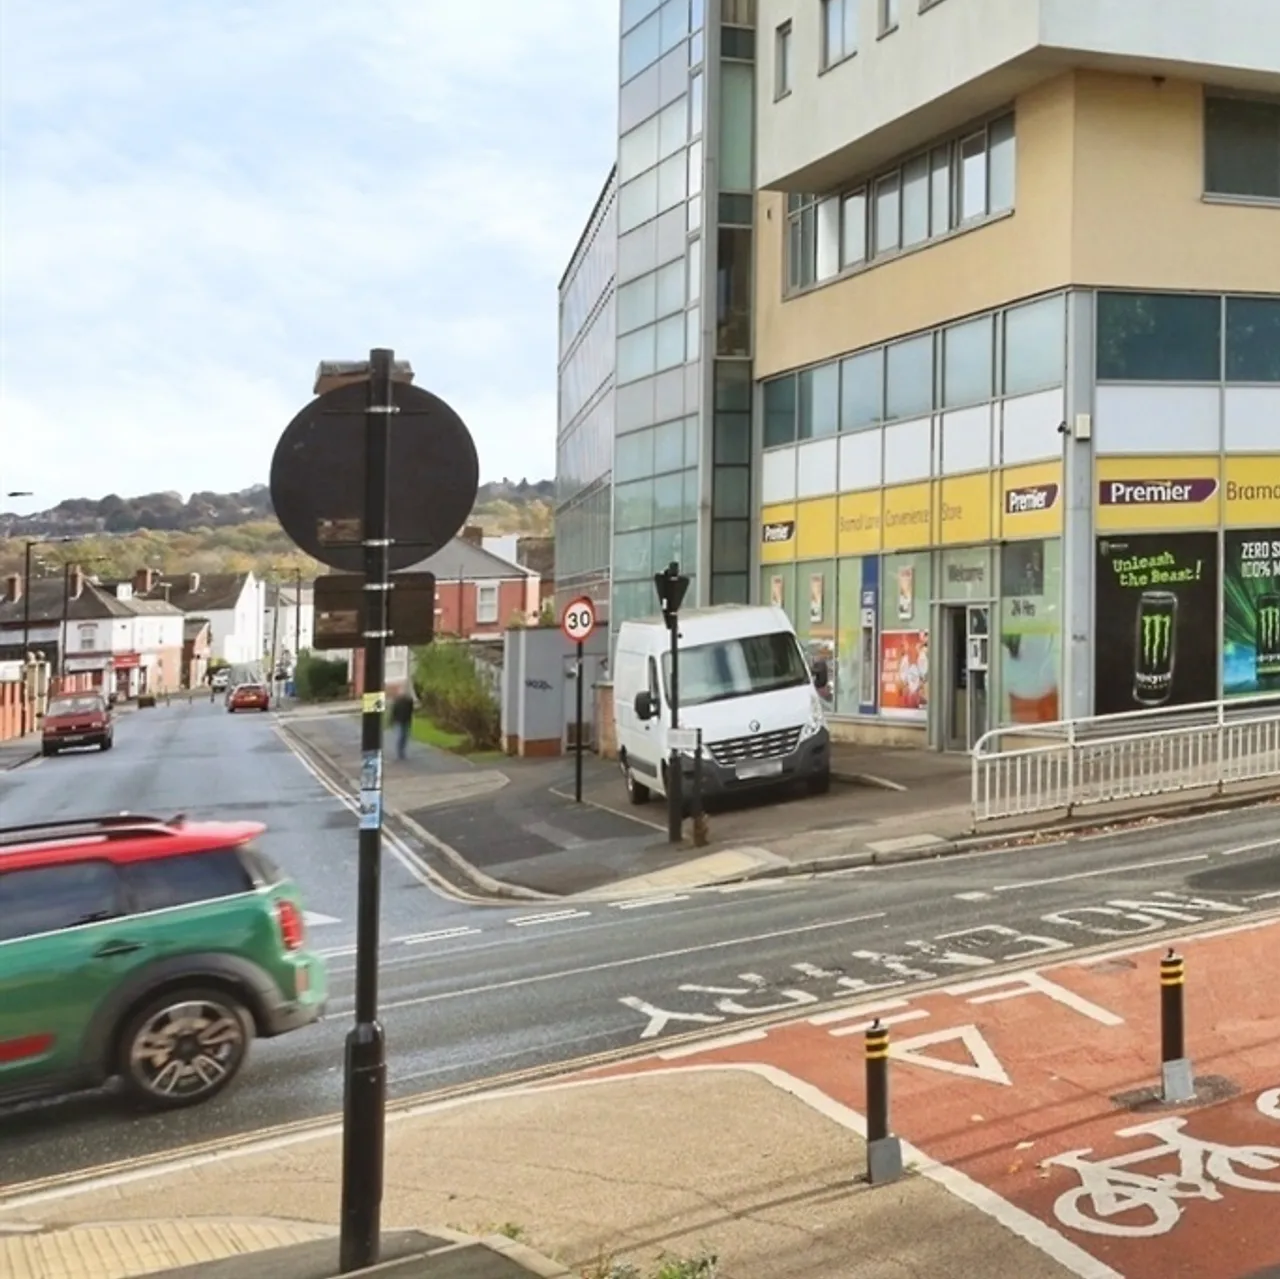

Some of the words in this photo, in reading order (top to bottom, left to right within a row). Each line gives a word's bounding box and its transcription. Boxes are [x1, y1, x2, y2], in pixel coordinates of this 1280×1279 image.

[1008, 489, 1048, 513] Premier
[1110, 482, 1192, 503] Premier
[1241, 541, 1270, 559] ZERO
[1112, 550, 1175, 573] Unleash
[1241, 560, 1271, 579] 100%
[1119, 572, 1149, 588] the
[568, 610, 591, 630] 30
